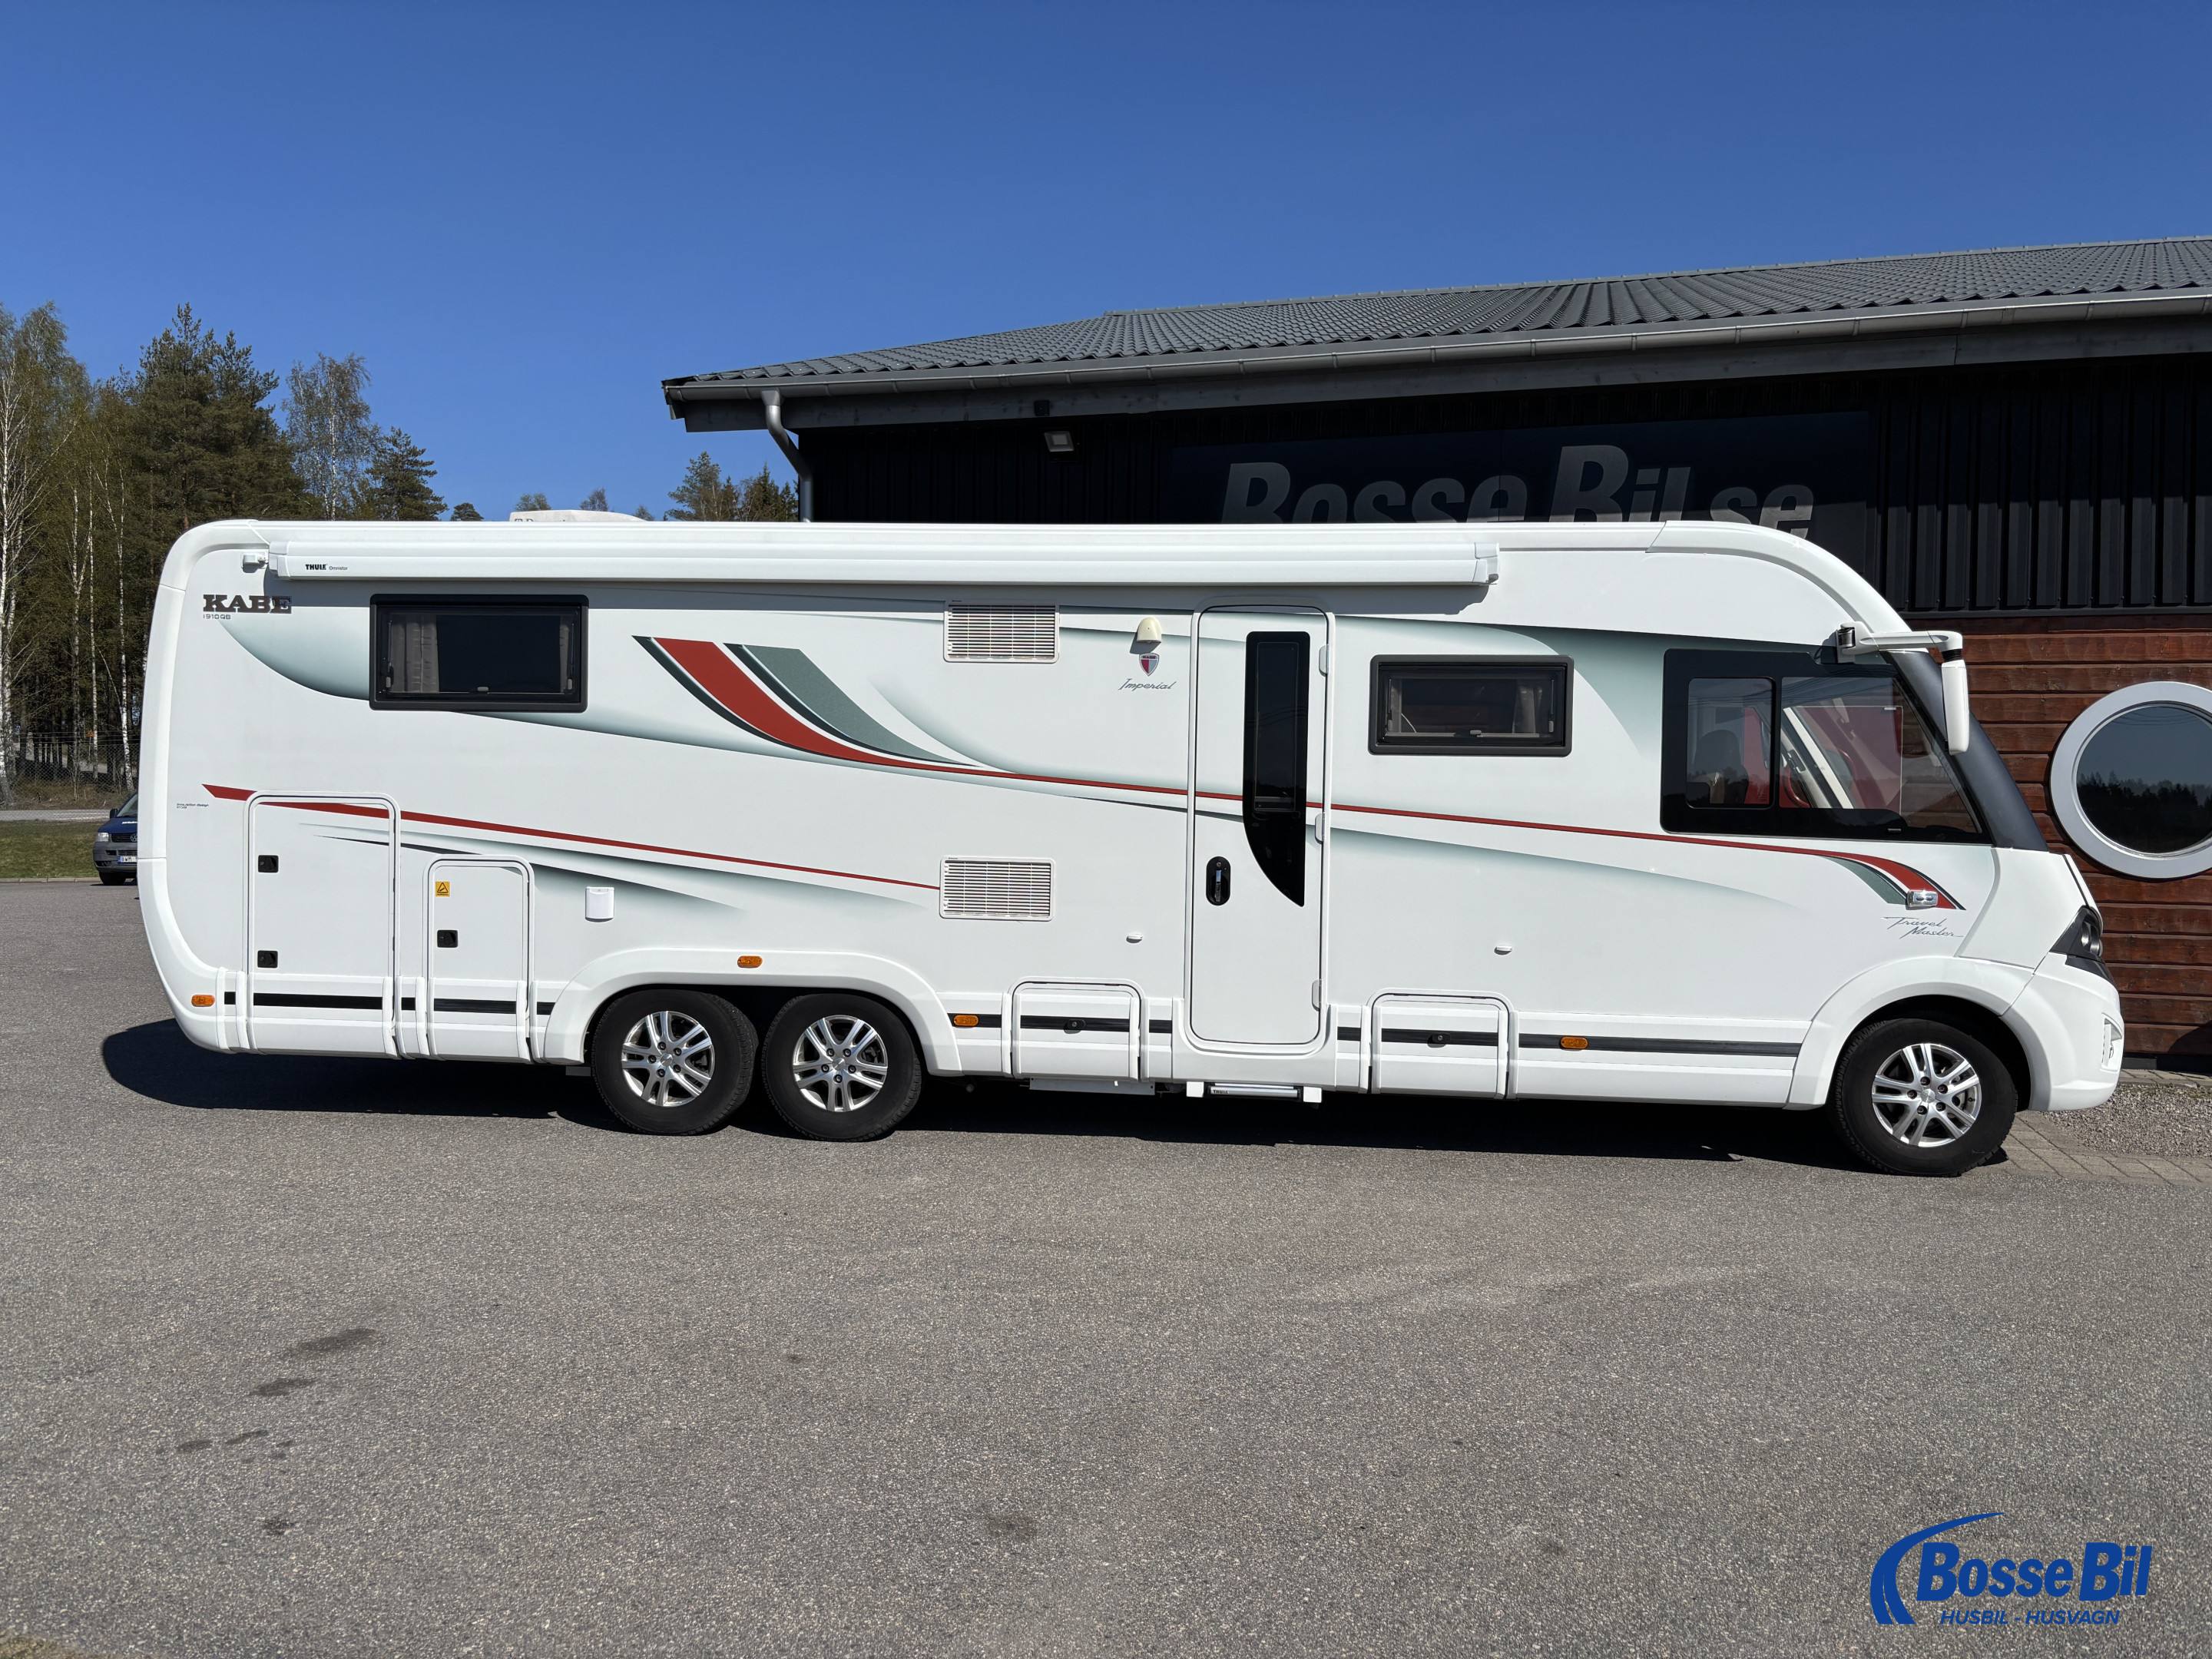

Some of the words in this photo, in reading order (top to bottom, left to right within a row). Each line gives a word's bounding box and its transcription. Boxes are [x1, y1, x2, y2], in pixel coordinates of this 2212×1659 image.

[1221, 462, 1528, 524] Bosse
[203, 594, 292, 614] KABE
[1118, 678, 1177, 692] Imperial
[1881, 916, 1948, 929] Travel
[1899, 926, 1964, 939] Master
